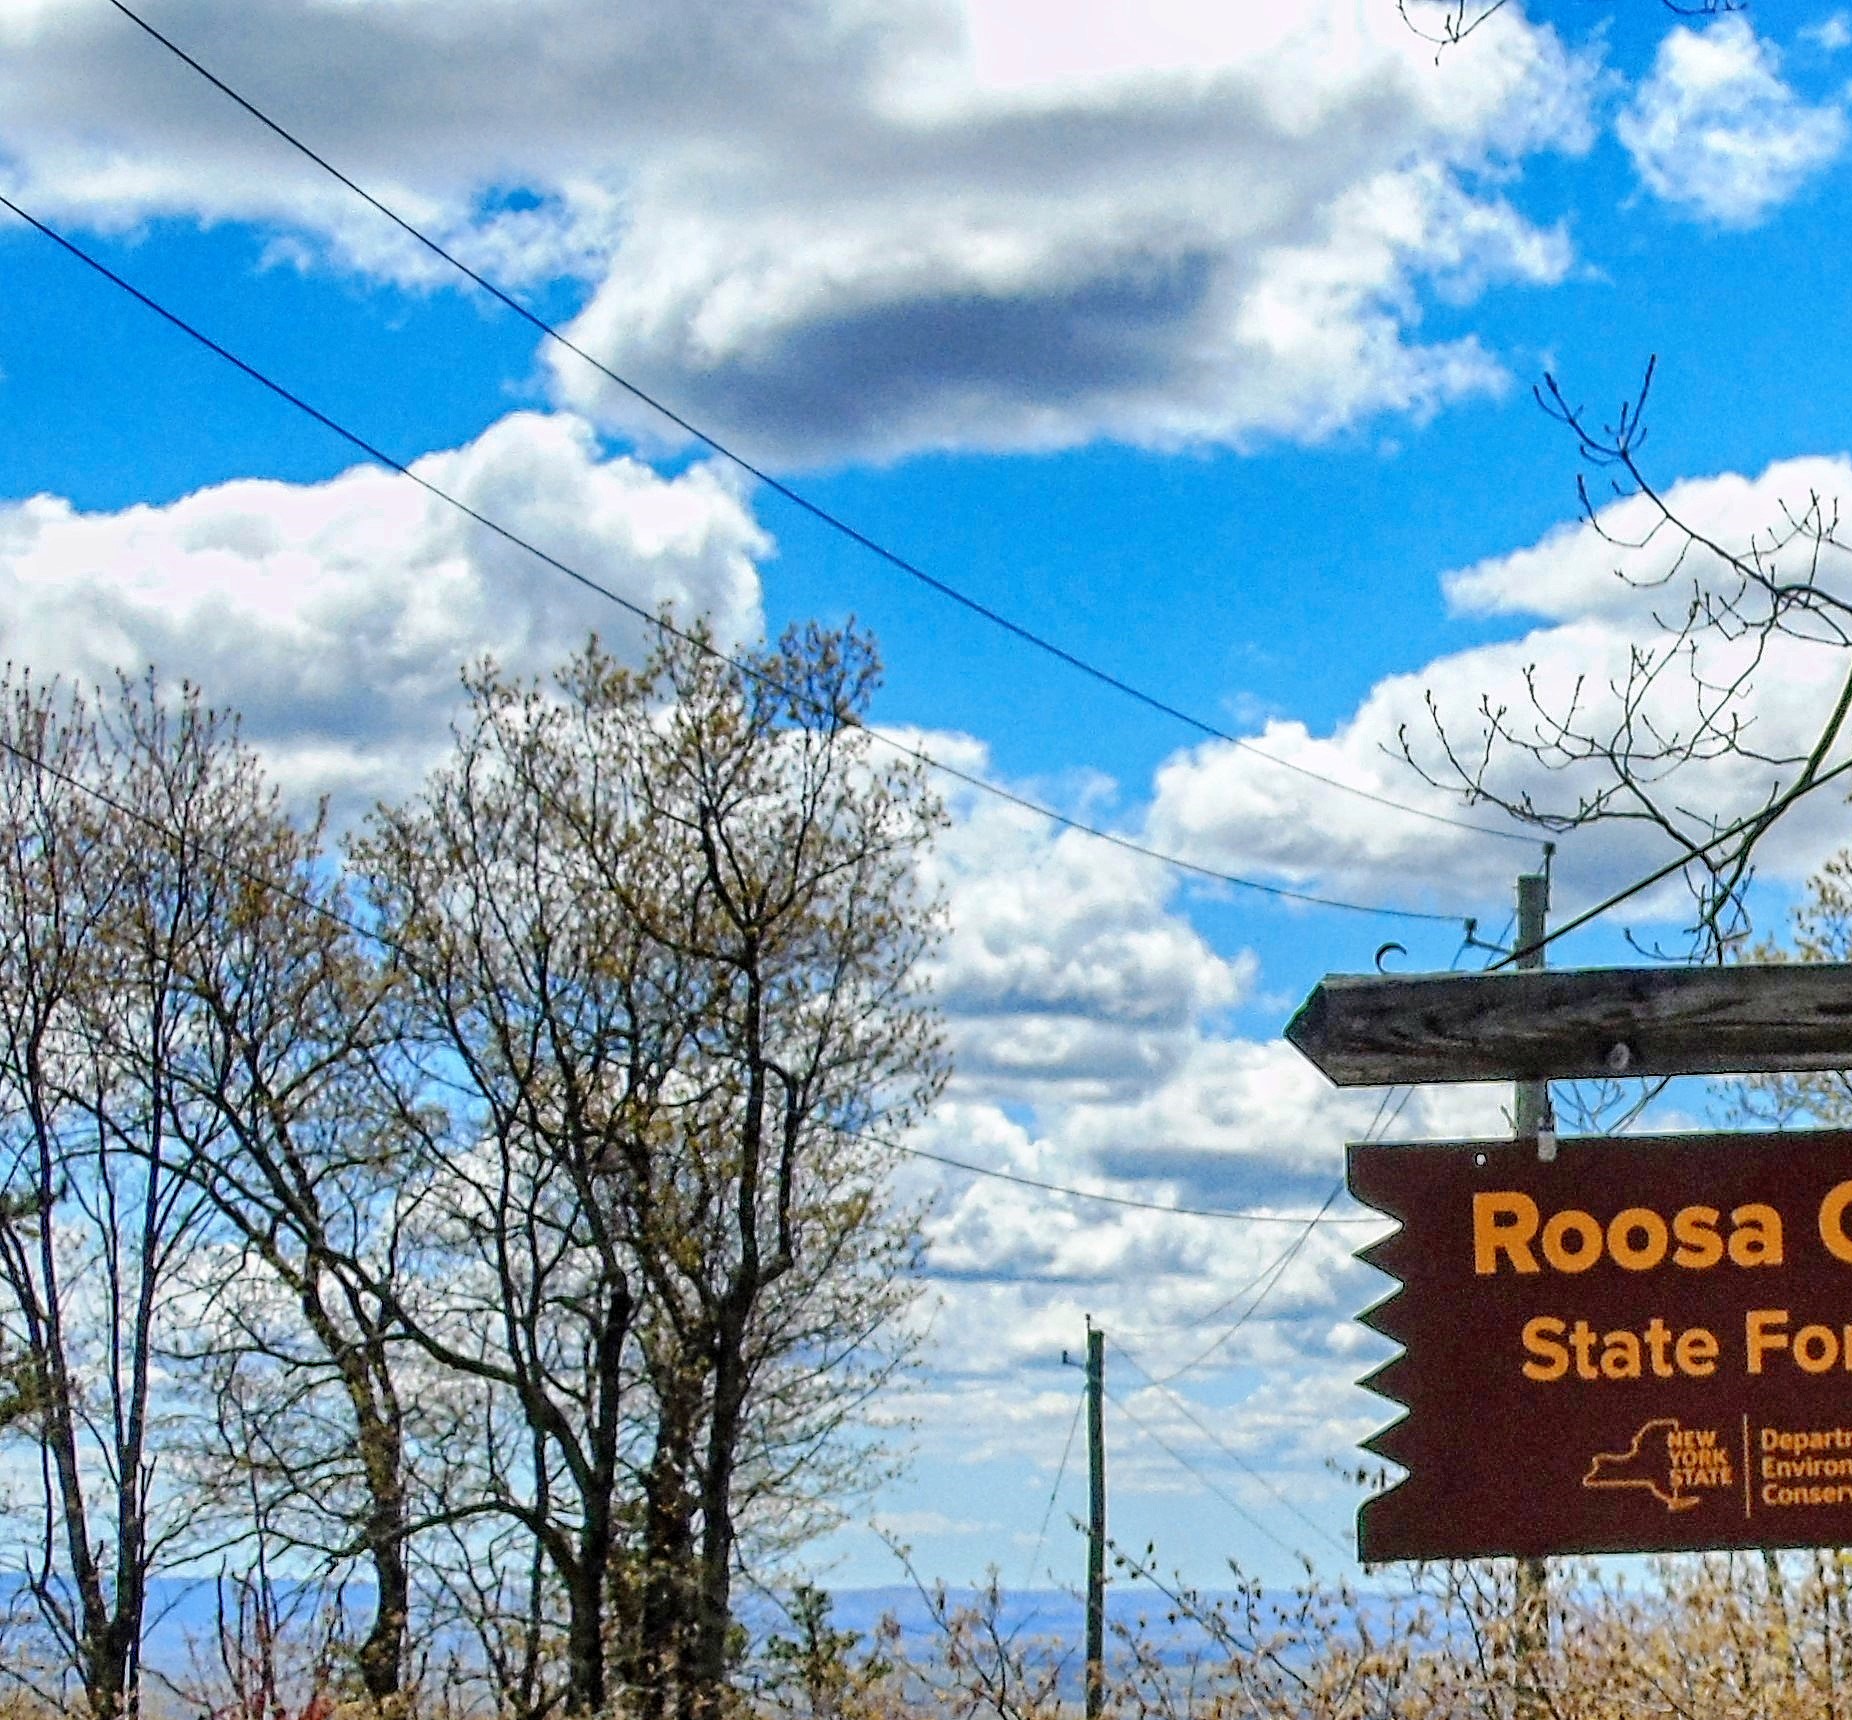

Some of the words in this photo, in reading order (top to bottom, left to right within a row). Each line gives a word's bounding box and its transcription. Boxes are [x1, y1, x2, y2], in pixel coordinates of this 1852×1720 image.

[1472, 1190, 1784, 1275] Roosa
[1521, 1315, 1720, 1381] State
[1667, 1429, 1717, 1449] NEW
[1669, 1448, 1729, 1468] YORK
[1670, 1467, 1733, 1489] STATE
